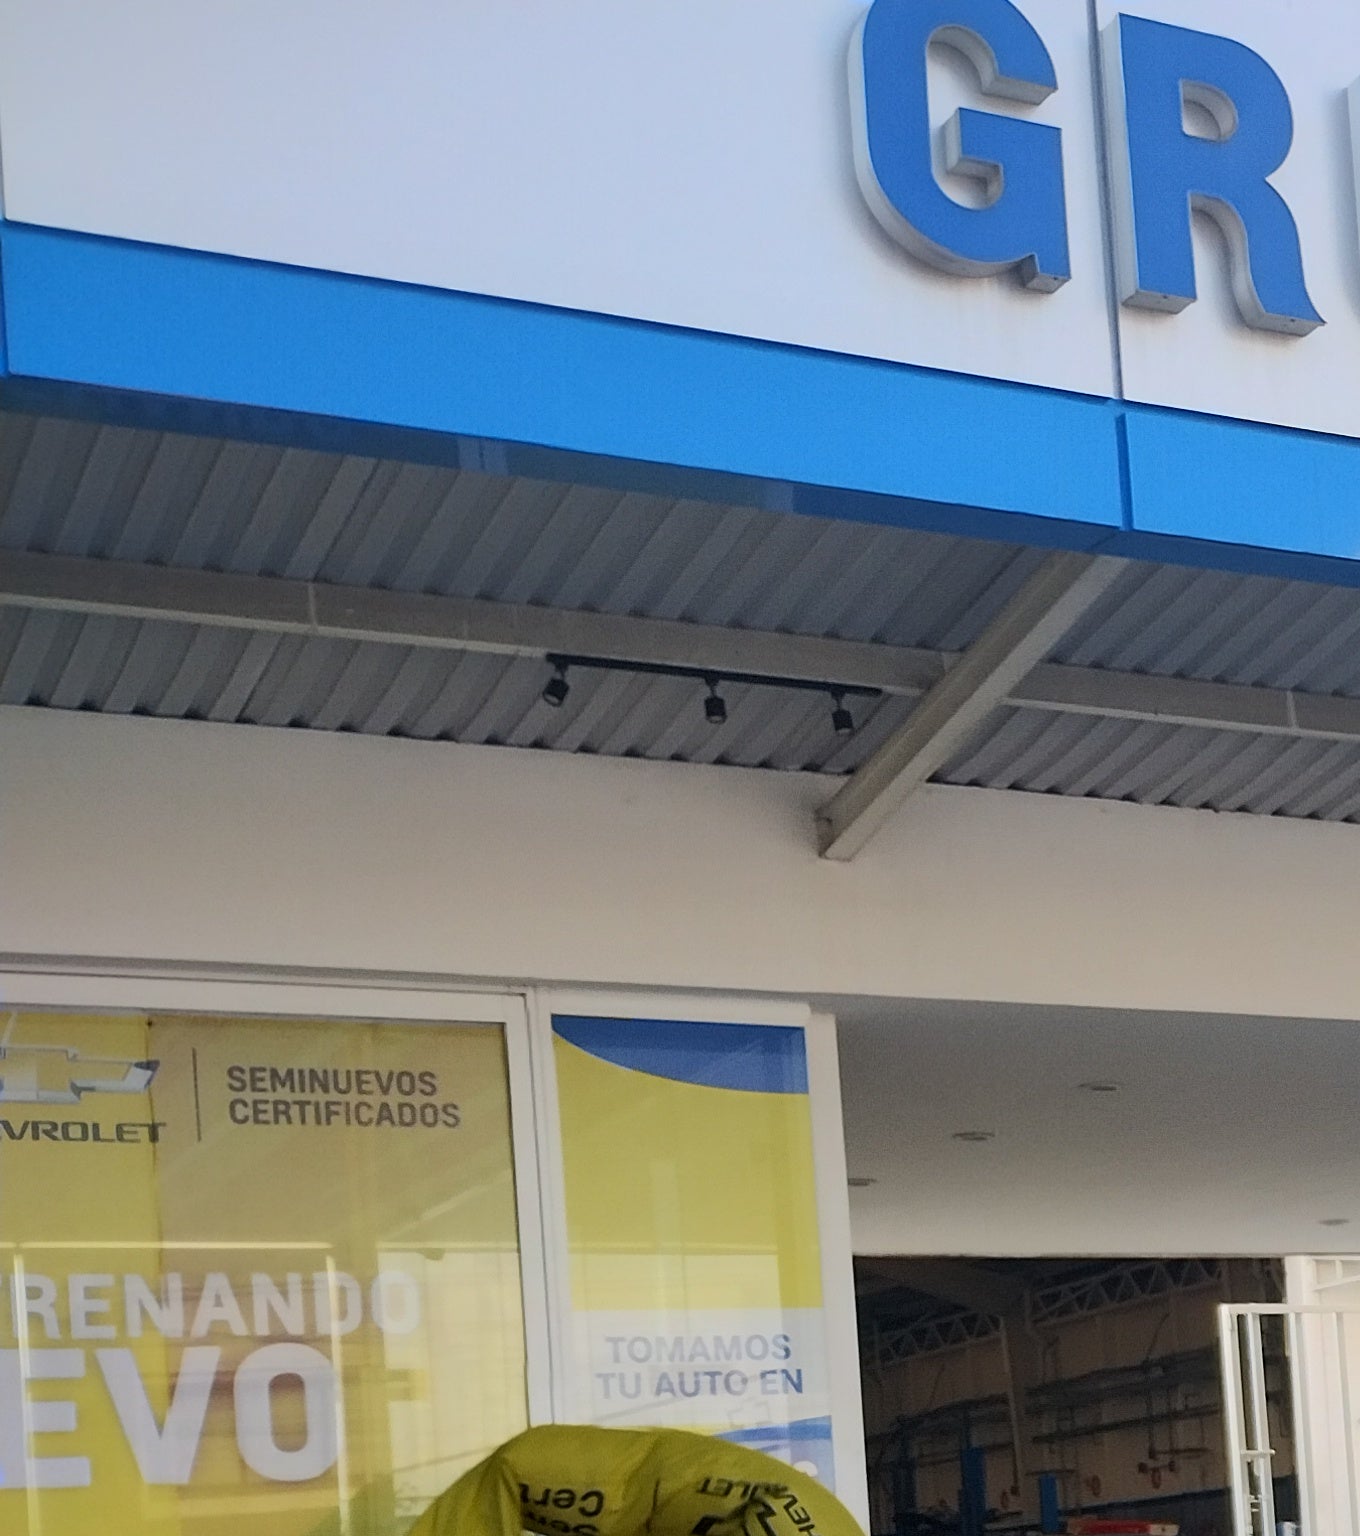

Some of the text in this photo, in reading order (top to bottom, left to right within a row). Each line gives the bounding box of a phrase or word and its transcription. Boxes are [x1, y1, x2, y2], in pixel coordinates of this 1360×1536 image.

[226, 1065, 438, 1096] SEMINUEVOS
[228, 1099, 462, 1129] CERTIFICADOS
[0, 1271, 422, 1340] RENANDO
[604, 1334, 792, 1364] TOMAMOS
[595, 1368, 804, 1399] TU AUTO EN
[0, 1342, 344, 1489] EVO
